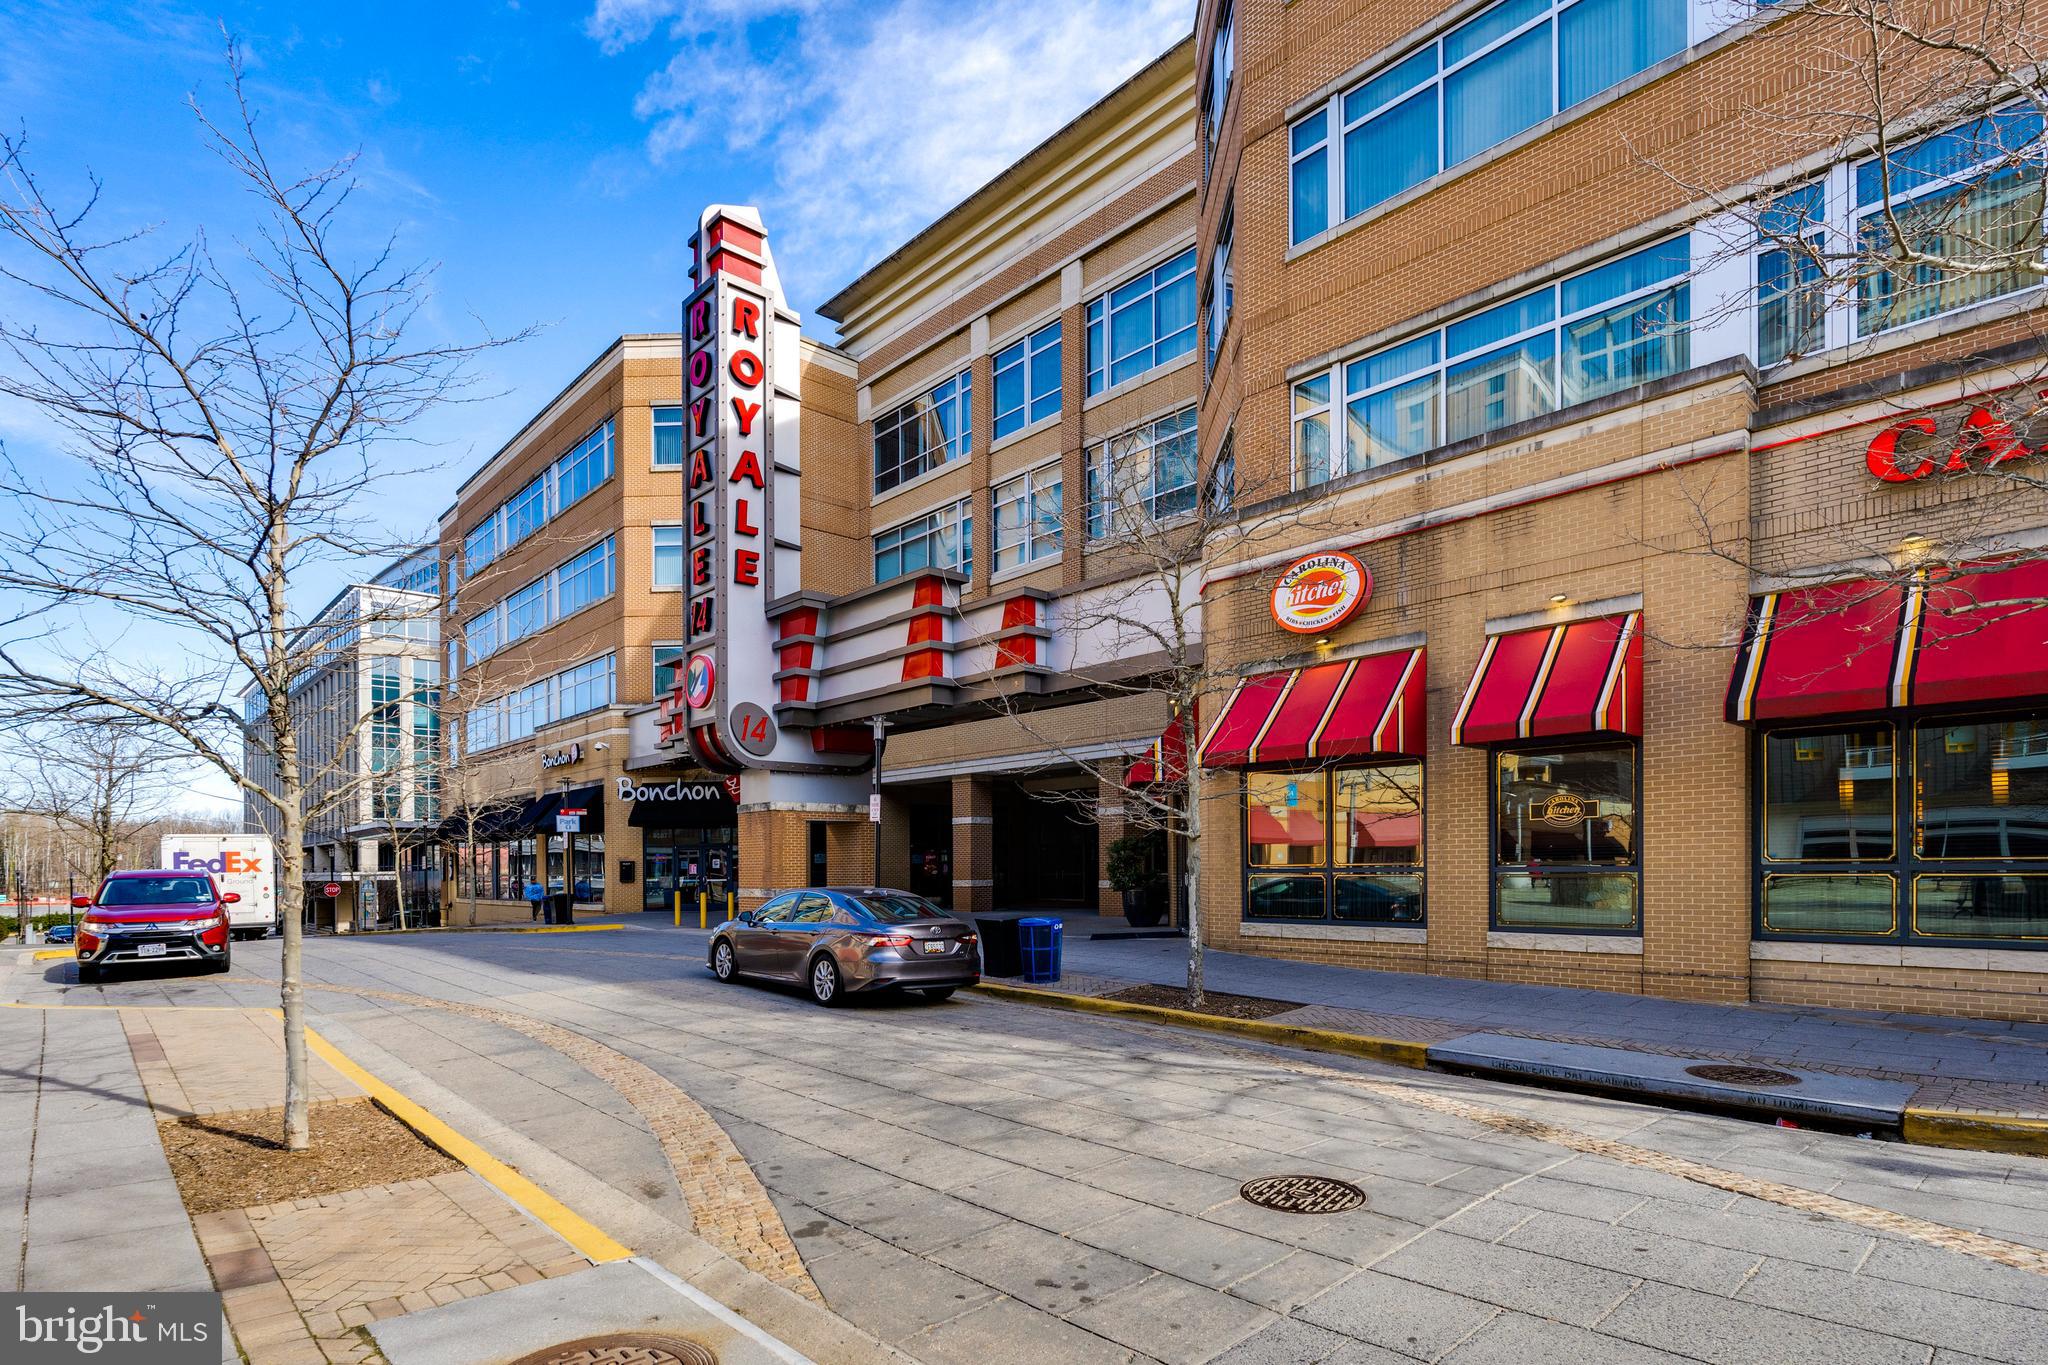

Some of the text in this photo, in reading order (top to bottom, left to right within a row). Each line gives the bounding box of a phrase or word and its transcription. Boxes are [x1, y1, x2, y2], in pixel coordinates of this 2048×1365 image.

[729, 296, 765, 586] ROYALE
[1866, 388, 2048, 483] CA
[690, 300, 713, 636] ROYALE 14
[1284, 557, 1346, 585] CAROLINA
[1302, 616, 1328, 626] CHICKEN
[1332, 605, 1346, 617] FISH
[740, 714, 769, 743] 14
[541, 747, 571, 769] Bonchon
[616, 777, 720, 801] Bonchon
[560, 817, 577, 825] Park
[173, 851, 262, 873] FedEx
[1564, 1071, 1582, 1081] BAY
